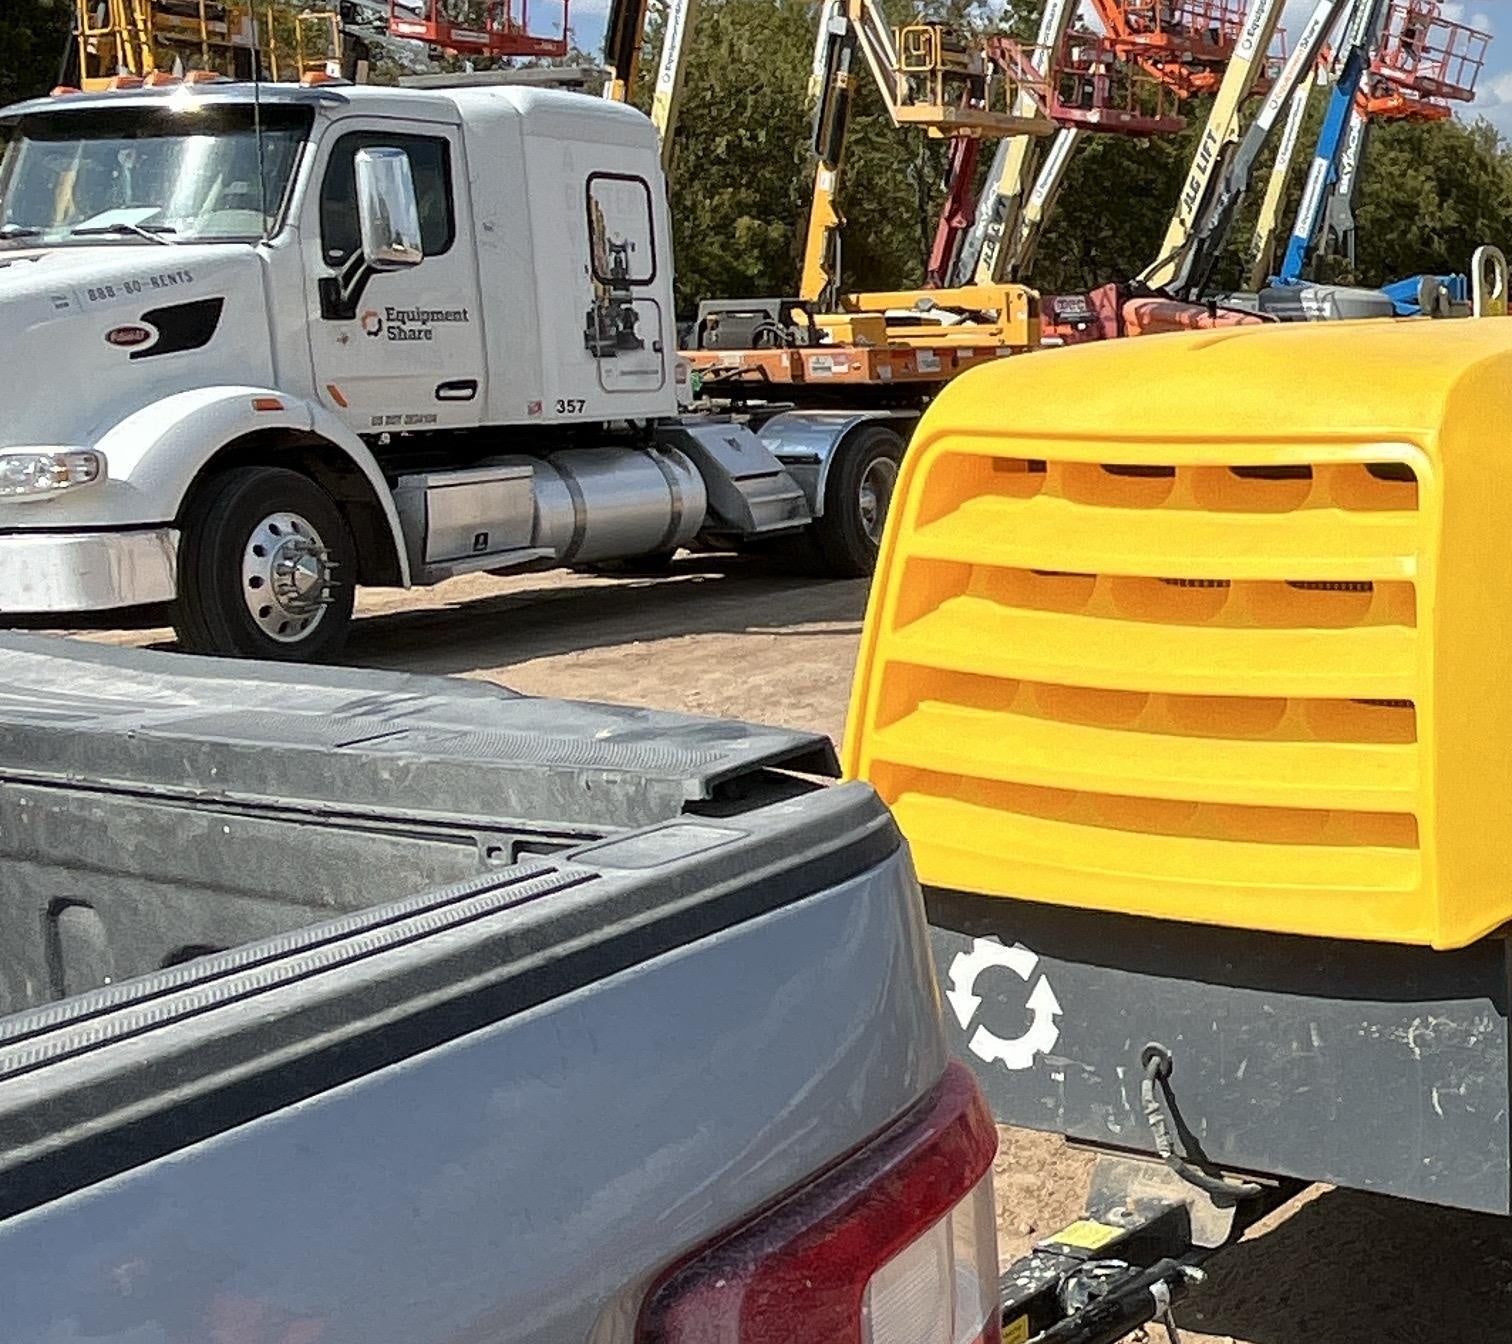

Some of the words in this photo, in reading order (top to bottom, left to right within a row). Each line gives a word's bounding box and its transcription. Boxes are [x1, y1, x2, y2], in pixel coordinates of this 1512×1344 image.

[1181, 174, 1202, 217] JLG
[1196, 128, 1219, 176] LIFT
[384, 306, 470, 326] Equipment
[386, 325, 433, 341] Share
[556, 399, 586, 414] 357
